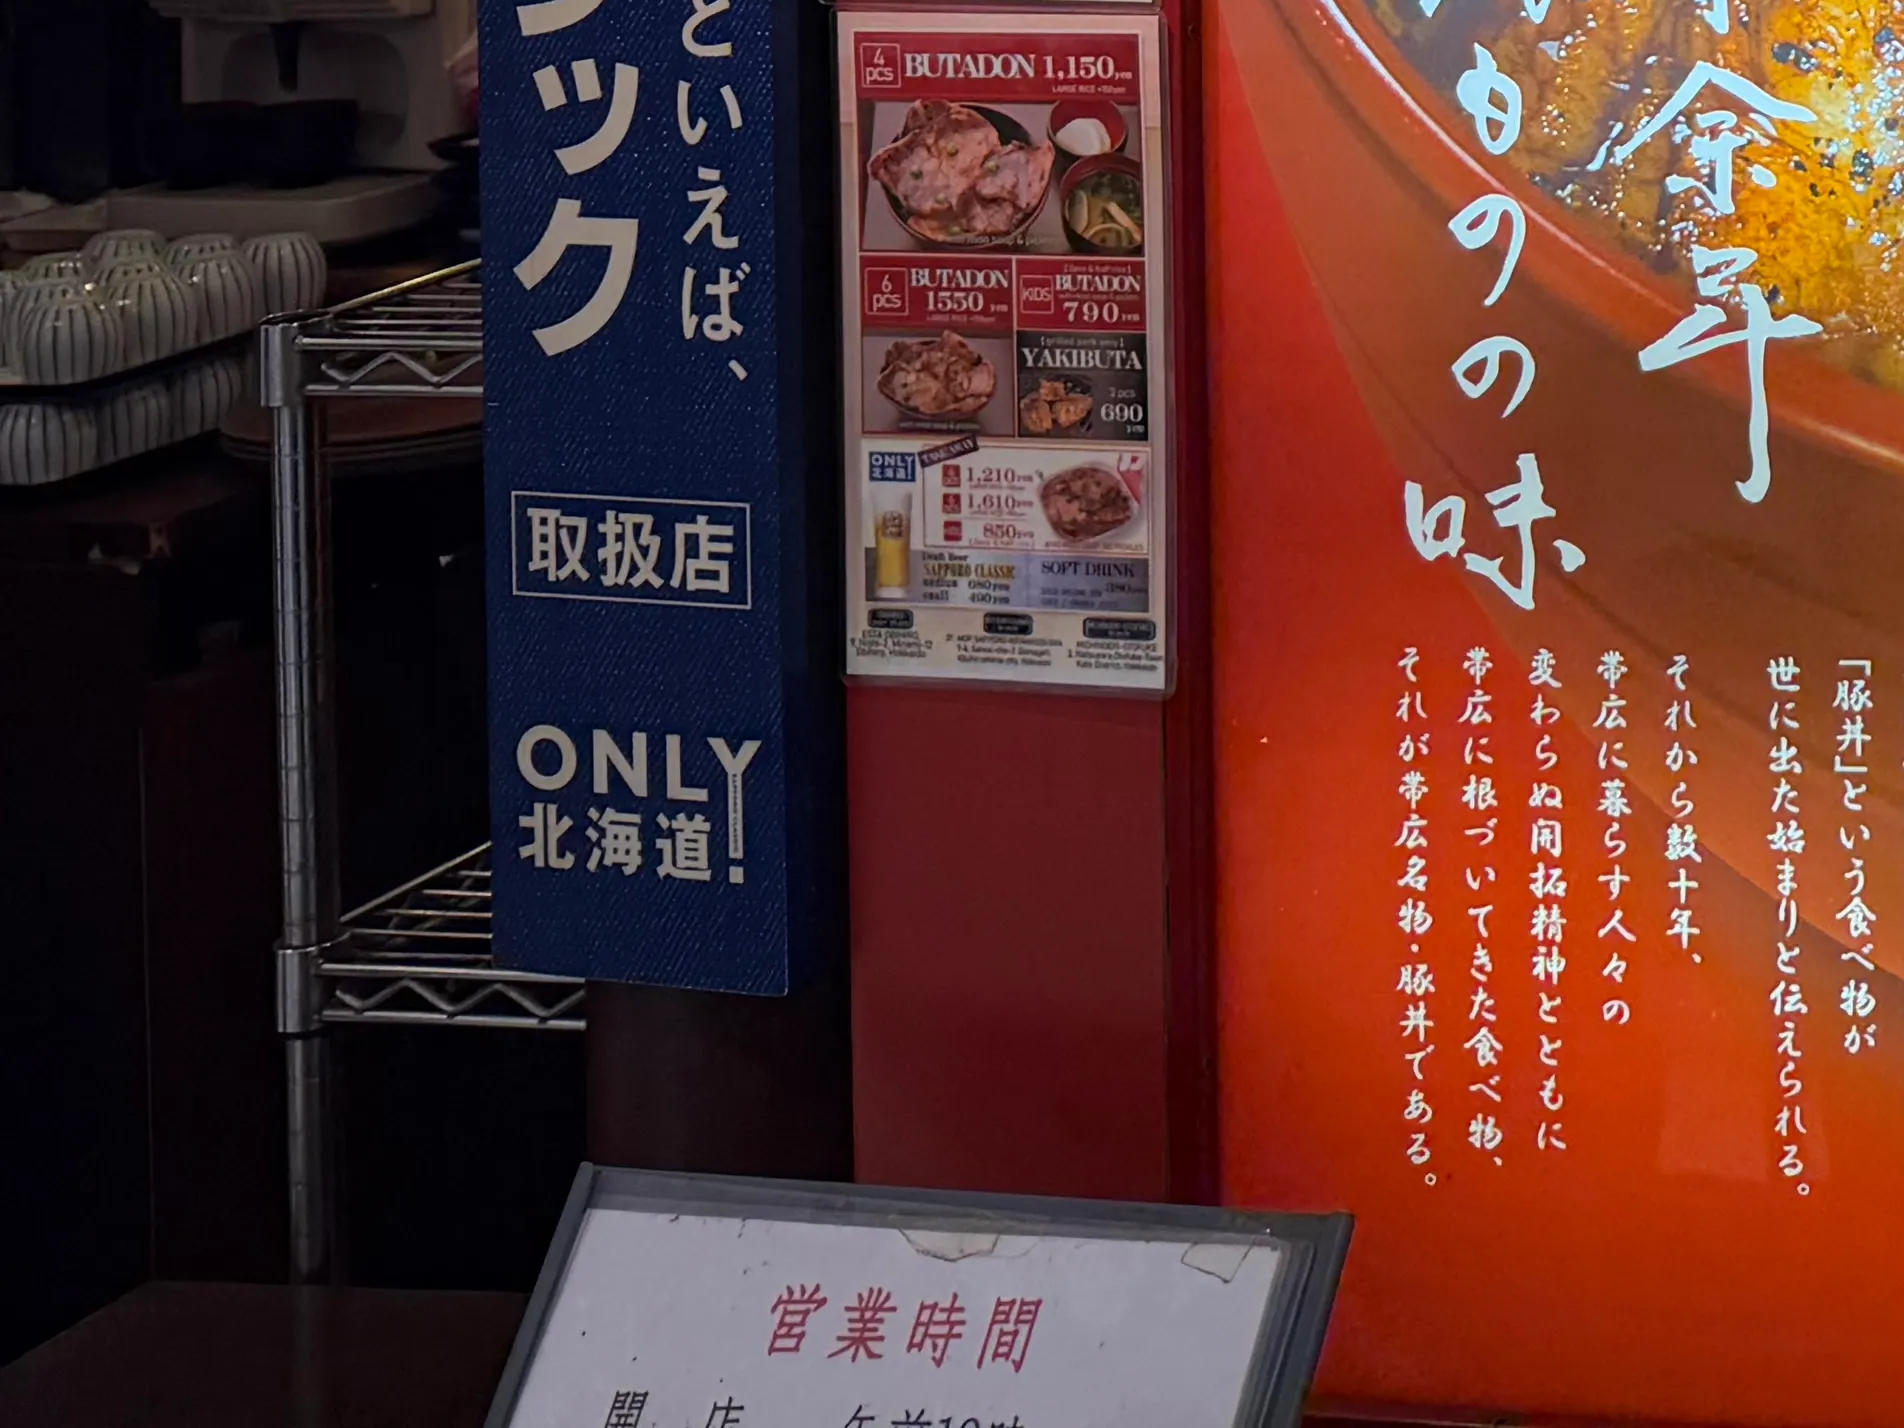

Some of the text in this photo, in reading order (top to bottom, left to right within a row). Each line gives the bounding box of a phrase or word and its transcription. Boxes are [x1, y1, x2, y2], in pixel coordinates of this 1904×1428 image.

[873, 50, 885, 65] 4
[904, 53, 1035, 79] BUTADON
[866, 66, 894, 84] pcs
[881, 274, 891, 289] 6
[911, 268, 1009, 288] BUTADON
[1056, 275, 1141, 292] BUTADON
[873, 293, 902, 309] pcs
[926, 292, 984, 312] 1550
[1022, 286, 1052, 302] KIDS
[1062, 302, 1119, 323] 790
[1021, 347, 1143, 371] YAKIBUTA
[1100, 402, 1143, 422] 690
[871, 454, 913, 466] ONLY
[527, 507, 735, 594] 取扱店
[516, 725, 762, 849] ONLY
[1665, 655, 1702, 963] それから数十年、
[1593, 650, 1636, 1024] 帯広に暮らす人々の
[1833, 660, 1876, 1053] 「豚丼」という食べ物が
[1458, 647, 1502, 1165] 帯広に根づいてきた食べ物、
[1529, 649, 1567, 1149] 変わらぬ開拓精神とともに
[1395, 648, 1436, 1185] それが帯広名物・豚丼である。
[1767, 657, 1809, 1195] 世に出た始まりと伝えられる。
[766, 1283, 1046, 1374] 営業時間
